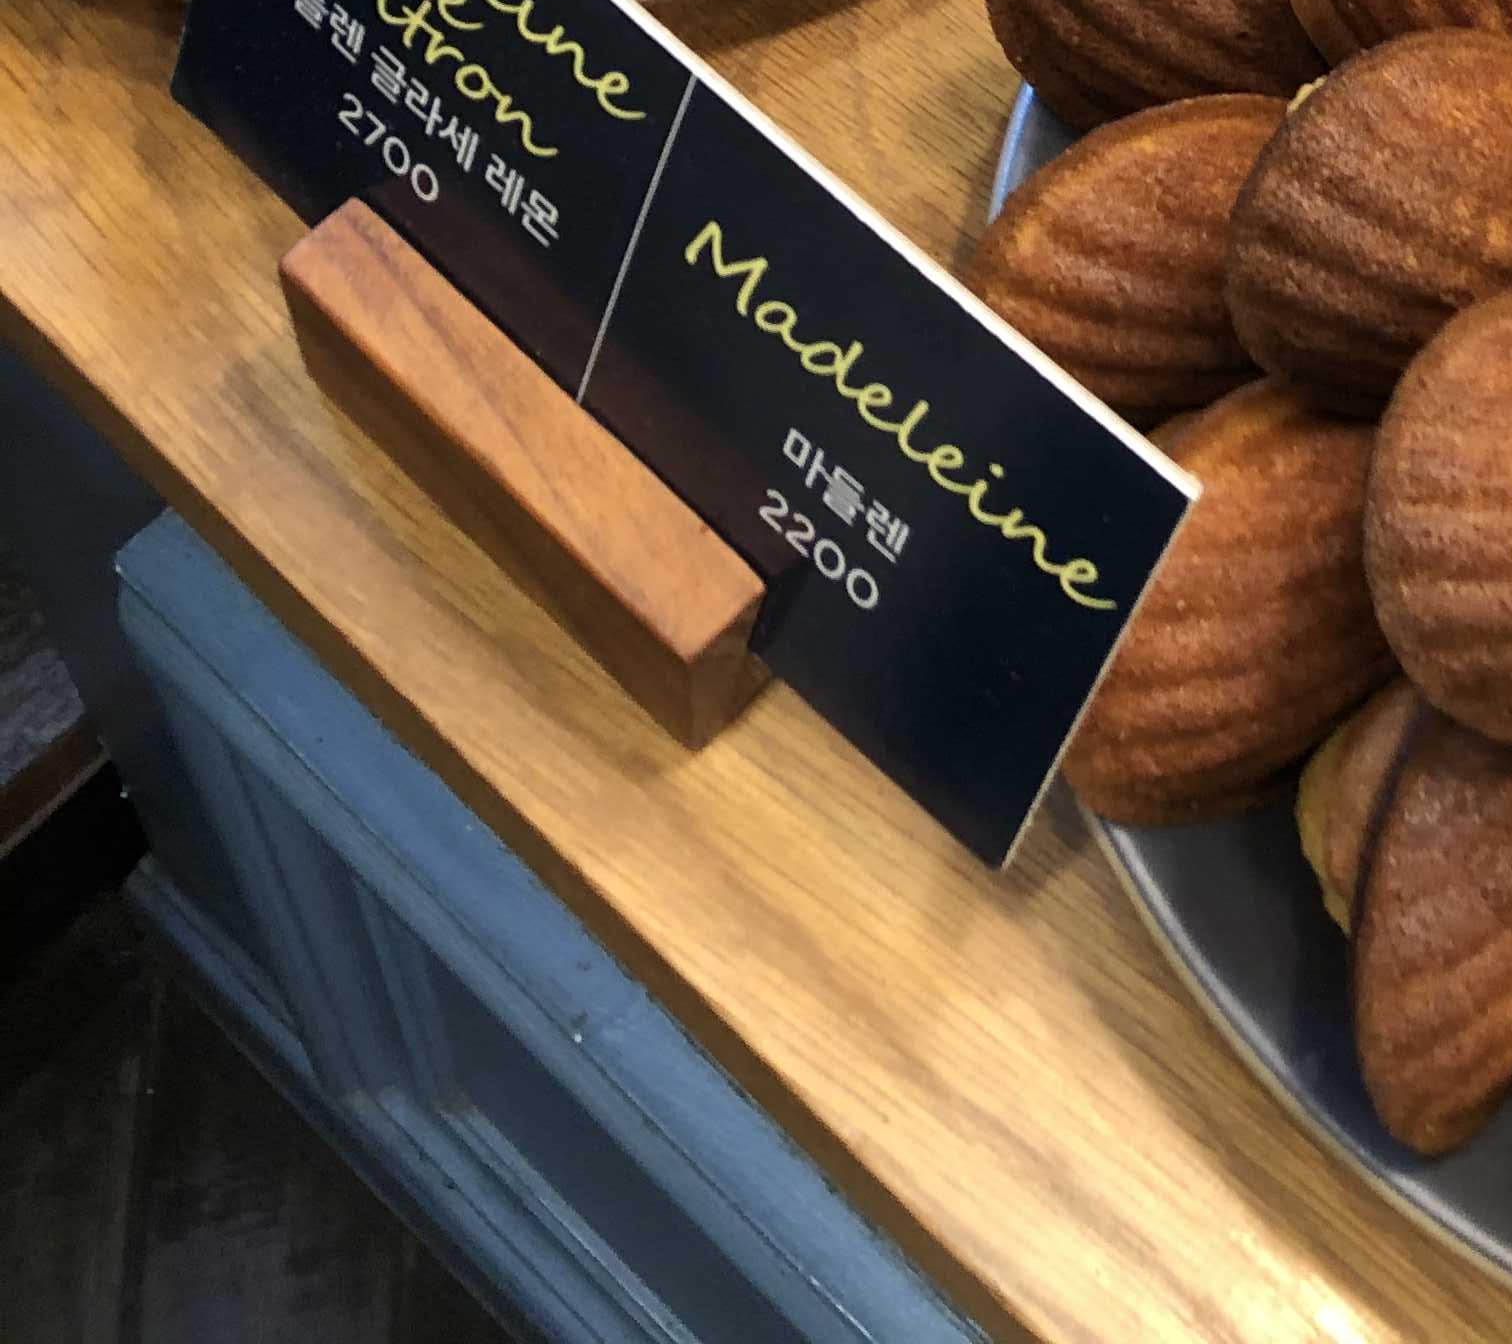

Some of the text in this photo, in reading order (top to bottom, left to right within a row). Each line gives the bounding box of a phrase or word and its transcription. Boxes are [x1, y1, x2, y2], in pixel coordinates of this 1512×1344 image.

[337, 91, 440, 204] 2700
[369, 45, 479, 174] 글라세
[483, 152, 561, 248] 레몬
[682, 220, 1118, 610] Madeleine
[756, 487, 880, 610] 2200
[781, 426, 911, 563] 마들렌
